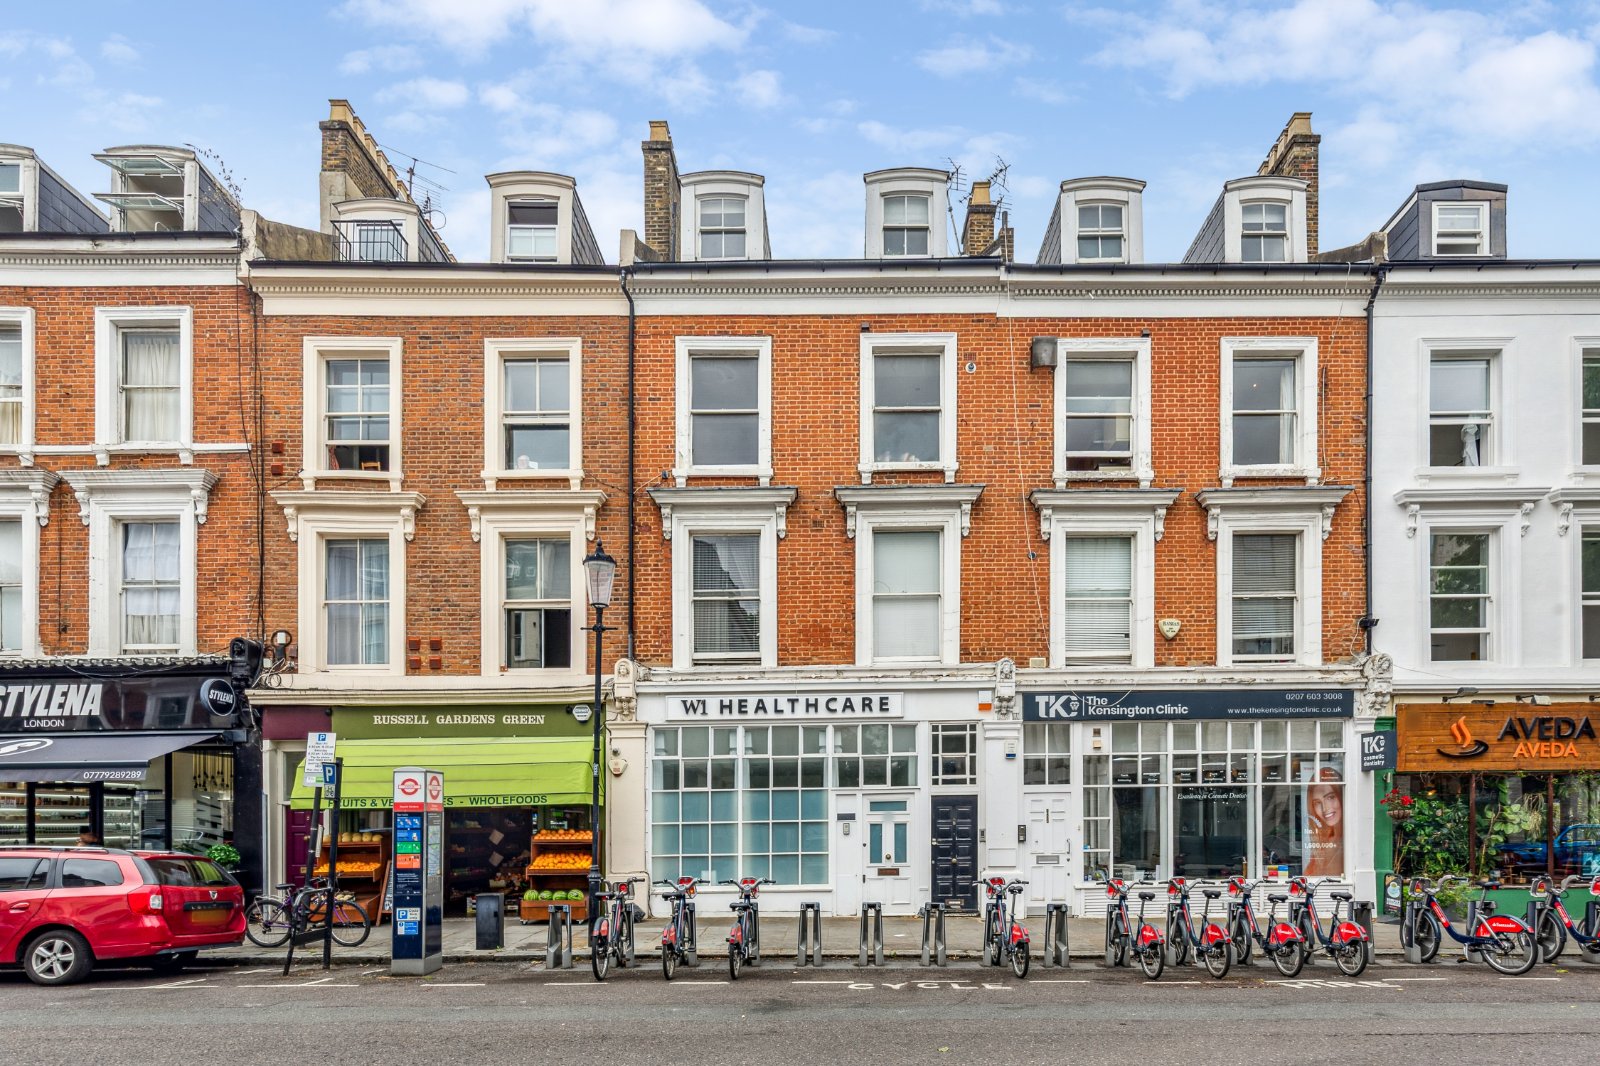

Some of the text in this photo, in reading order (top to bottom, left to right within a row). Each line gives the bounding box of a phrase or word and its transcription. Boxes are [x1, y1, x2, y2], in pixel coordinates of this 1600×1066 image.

[209, 689, 233, 704] STYLENA
[1086, 696, 1108, 705] The
[1323, 692, 1342, 700] 3008
[681, 696, 890, 715] W1 HEALTHCARE
[1088, 704, 1188, 717] Kensington Clinic
[1227, 706, 1342, 715] www.thekensingtonclinic.co.uk
[24, 719, 65, 727] LONDON
[373, 714, 545, 725] RUSSELL GARDENS GREEN
[1497, 716, 1596, 741] AVEDA
[1513, 742, 1579, 758] AVEDA
[83, 771, 141, 779] 07779289289
[328, 798, 367, 807] FUITS
[370, 798, 378, 807] &
[469, 795, 547, 806] WHOLEFOODS
[848, 982, 1012, 990] CYCLE
